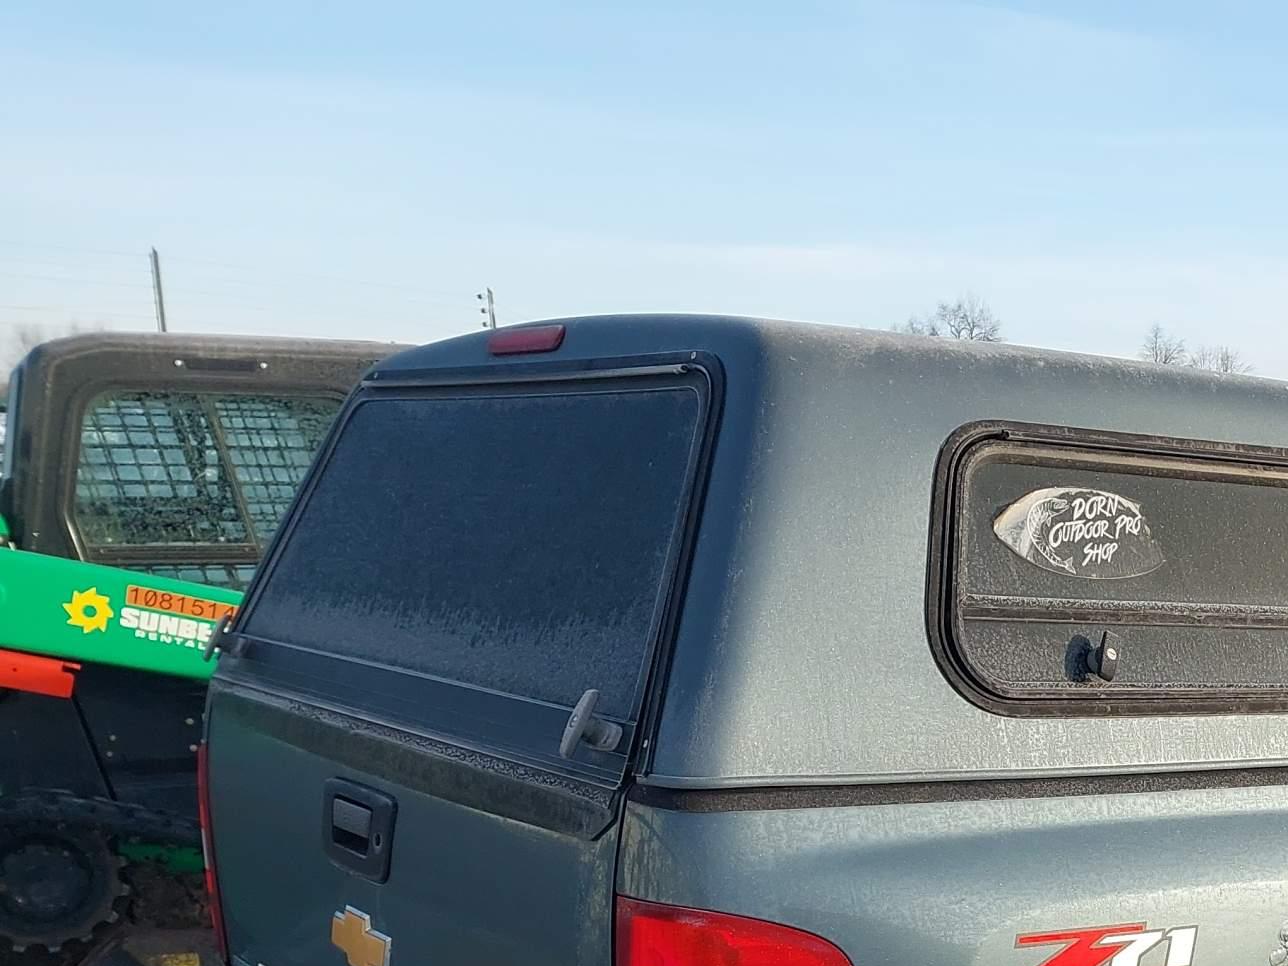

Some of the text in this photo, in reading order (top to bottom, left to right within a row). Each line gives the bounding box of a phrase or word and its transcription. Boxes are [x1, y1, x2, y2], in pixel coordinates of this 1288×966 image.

[1071, 495, 1118, 520] DORN
[1049, 514, 1142, 548] OUTDOOR PRO
[1081, 542, 1119, 567] SHOP
[119, 607, 213, 642] SUNBE
[134, 629, 207, 650] RENTAL
